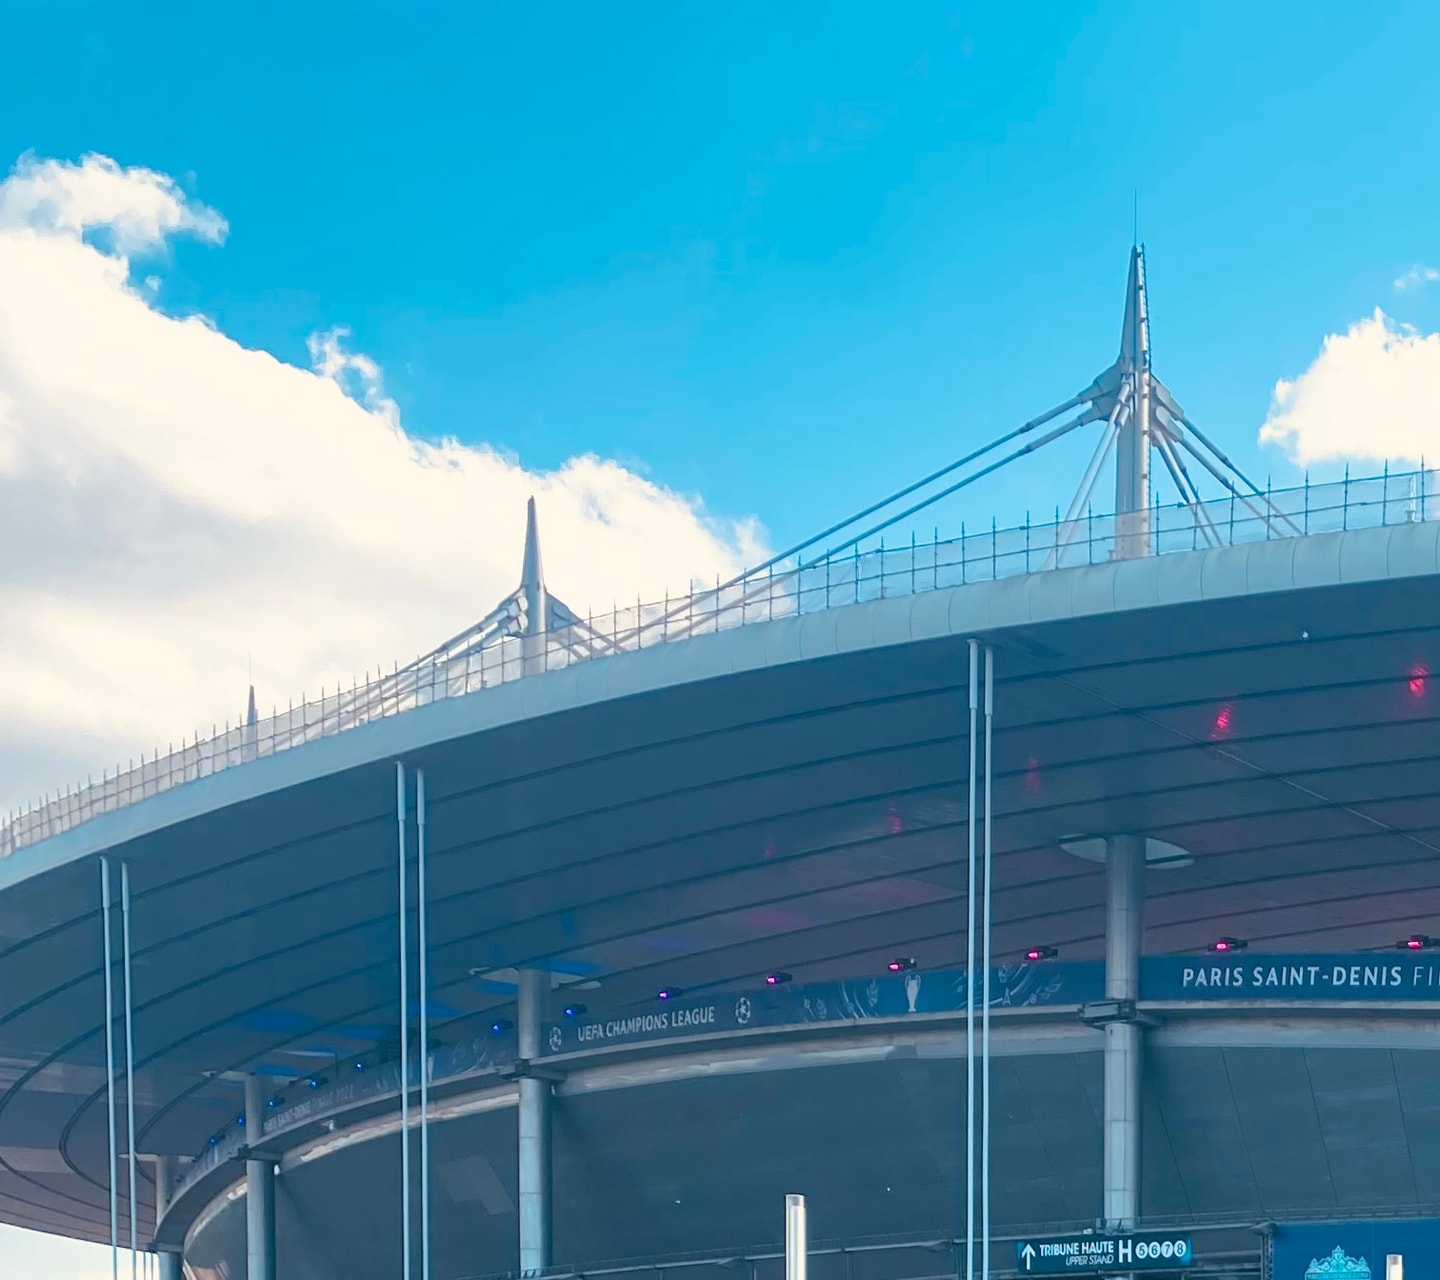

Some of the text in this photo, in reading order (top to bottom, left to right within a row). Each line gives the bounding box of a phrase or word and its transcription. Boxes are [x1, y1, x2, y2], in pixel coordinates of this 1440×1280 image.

[1183, 967, 1244, 988] PARIS
[1252, 966, 1402, 987] SAINT-DENIS
[577, 1006, 715, 1042] UEFA CHAMPIONS LEAGUE
[1039, 1241, 1114, 1257] TRIBUNE HAUTE
[1065, 1254, 1114, 1266] UPPER STAND
